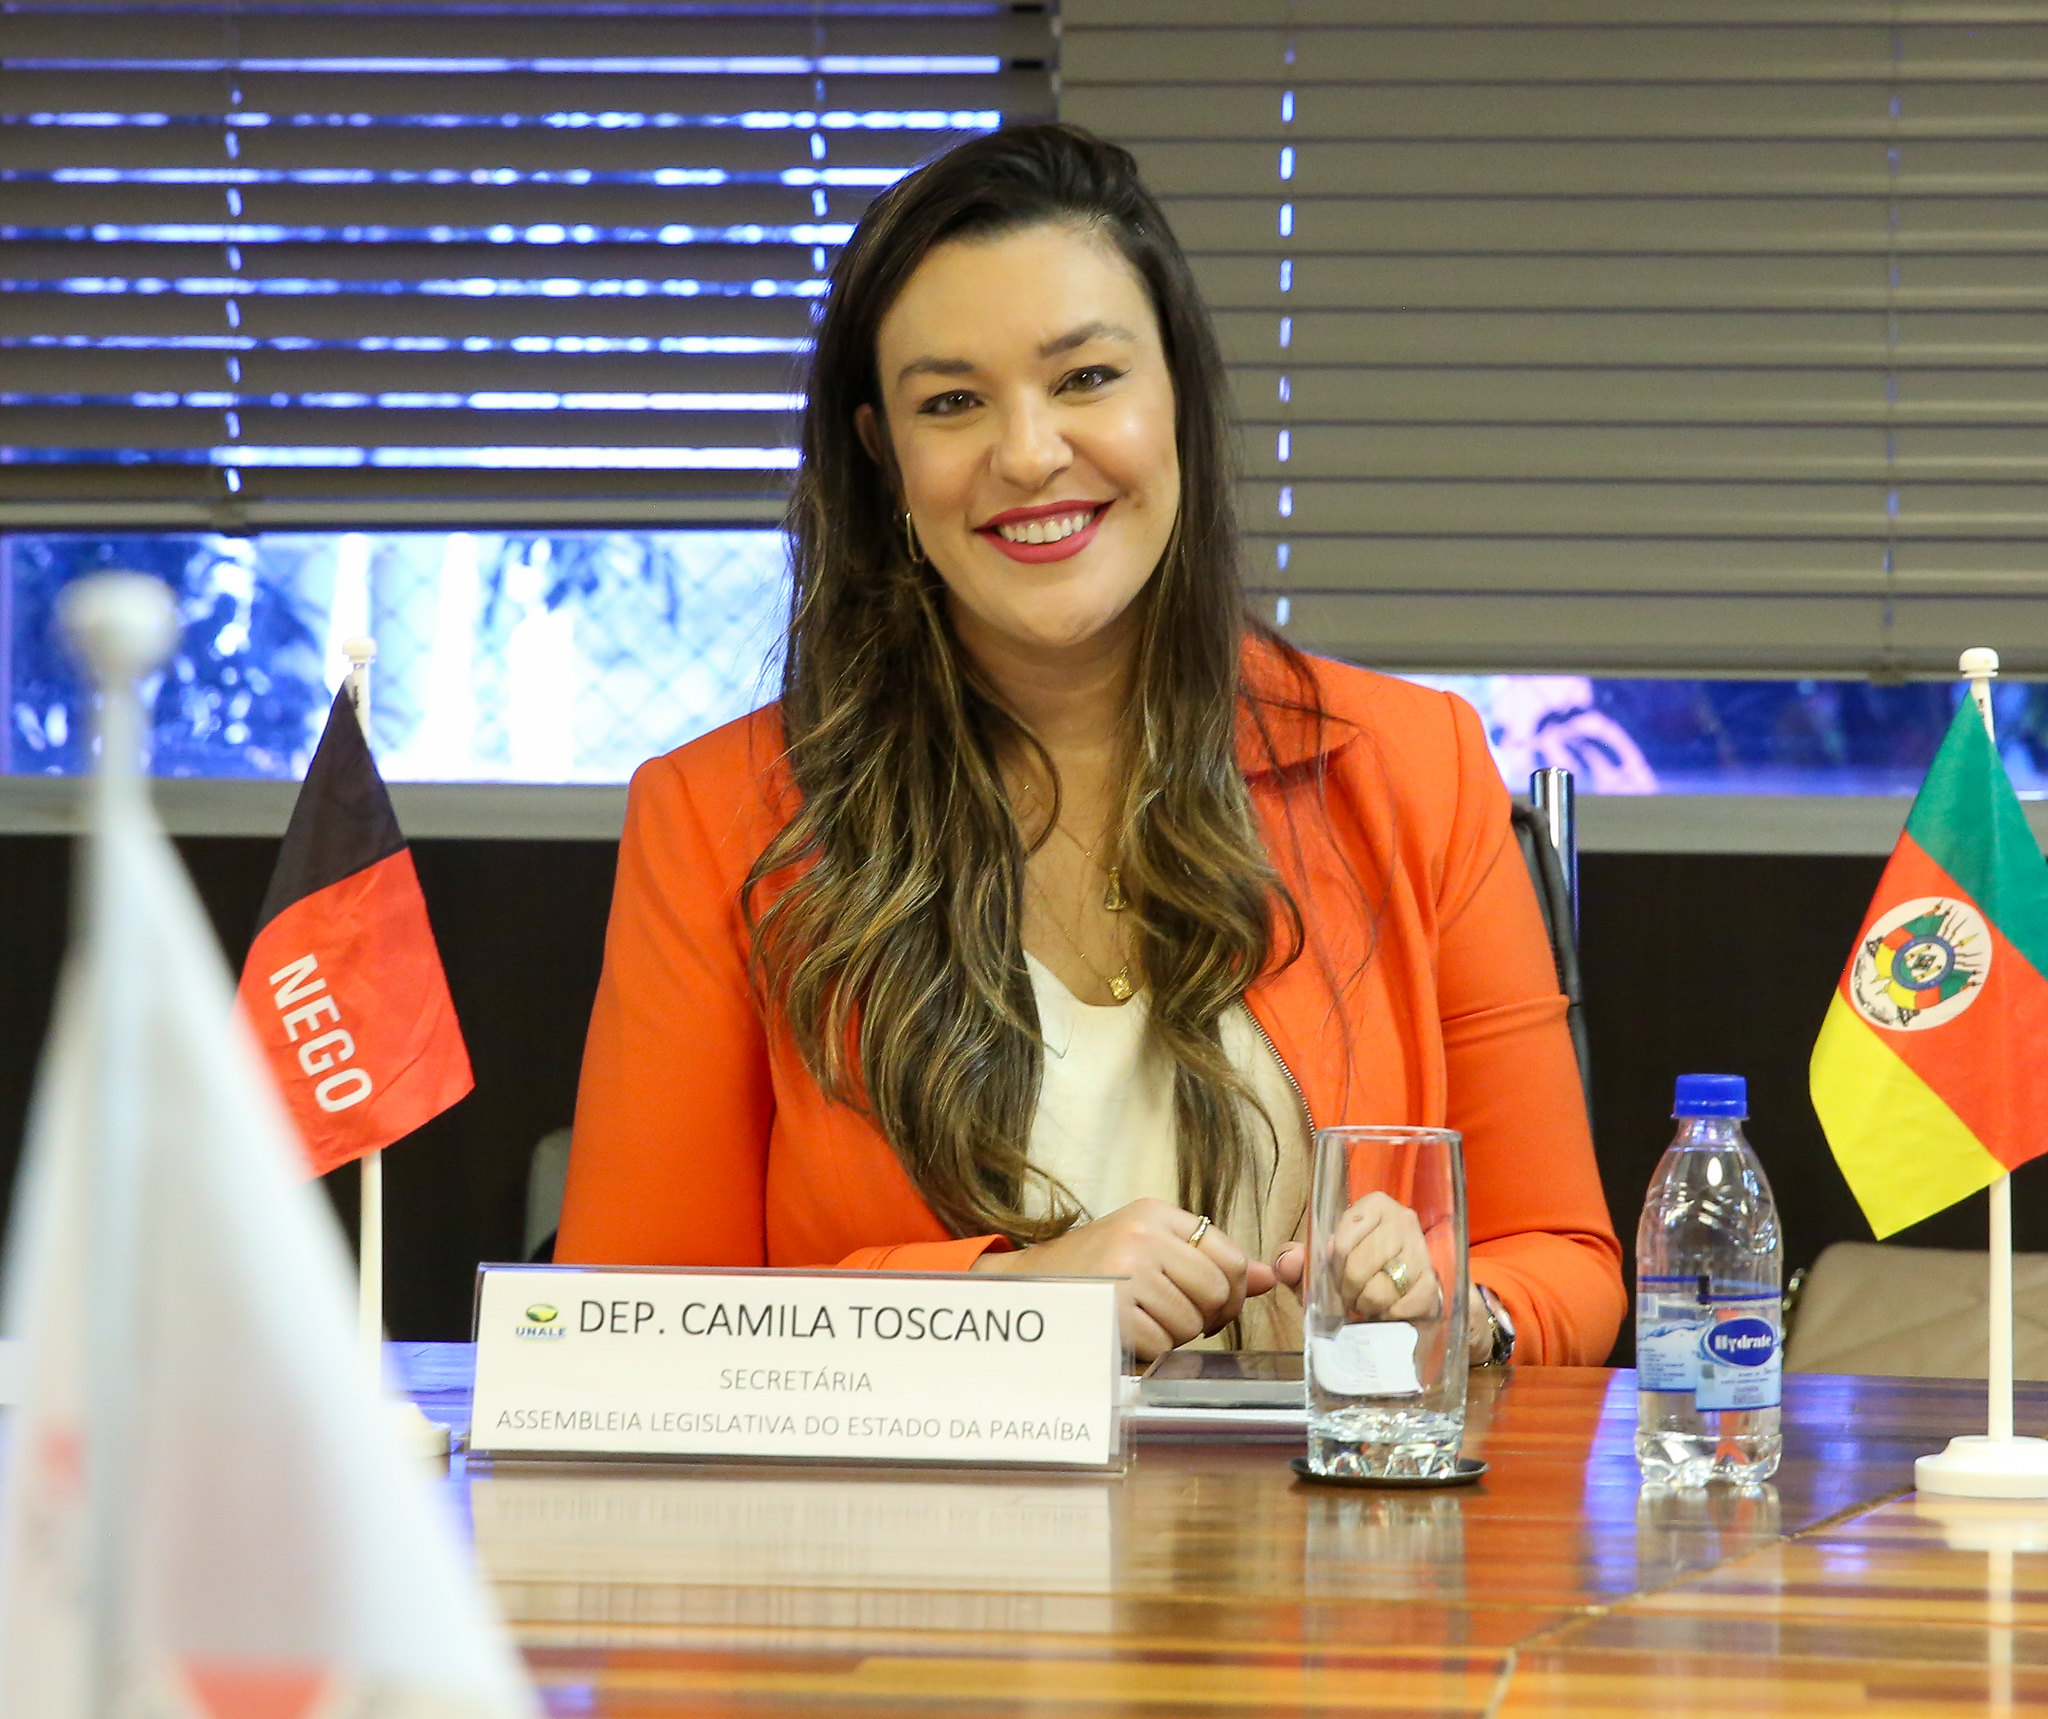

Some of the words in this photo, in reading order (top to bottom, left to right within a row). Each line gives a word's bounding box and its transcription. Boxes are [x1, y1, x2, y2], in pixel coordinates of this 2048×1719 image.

[268, 953, 373, 1113] NEGO
[514, 1326, 567, 1337] UNALE
[579, 1299, 666, 1335] DEP.
[681, 1302, 836, 1338] CAMILA
[848, 1305, 1045, 1343] TOSCANO
[719, 1366, 873, 1393] SECRETÁRIA
[496, 1408, 643, 1431] ASSEMBLEIA
[650, 1411, 797, 1435] LEGISLATIVA
[804, 1415, 840, 1436] DO
[847, 1416, 941, 1438] ESTADO
[949, 1418, 982, 1440] DA
[989, 1416, 1092, 1442] PARAÍBA
